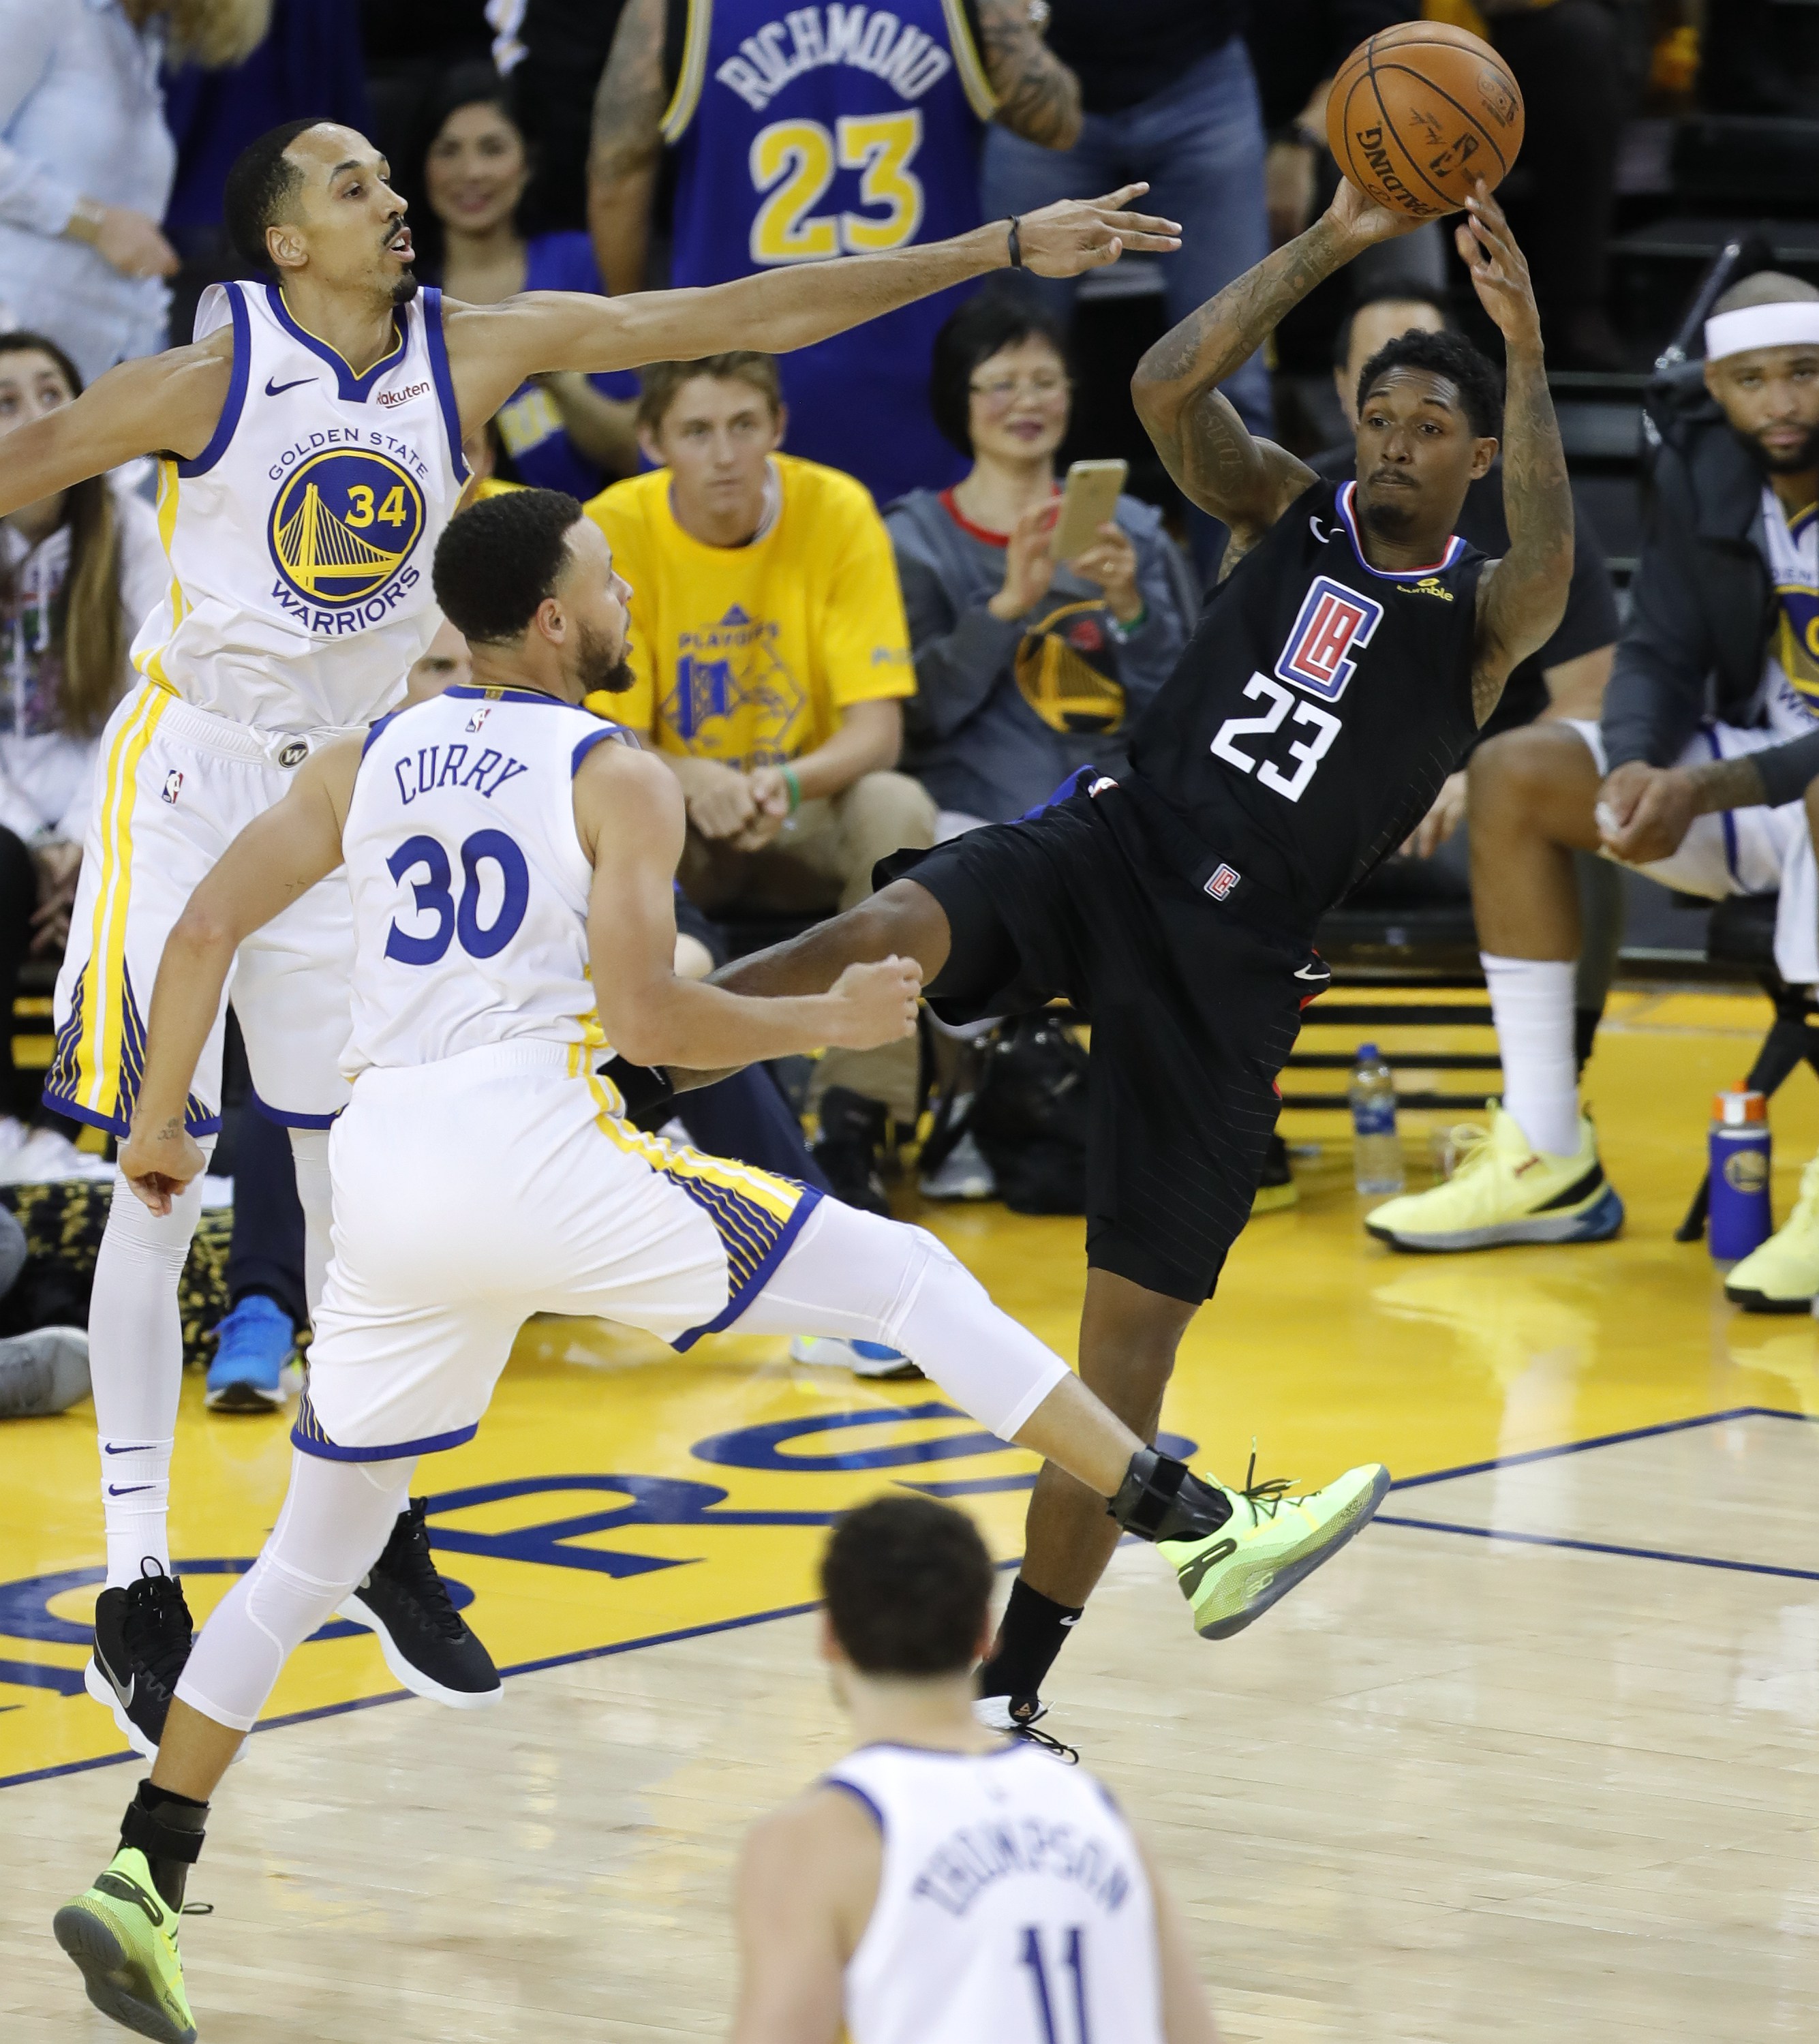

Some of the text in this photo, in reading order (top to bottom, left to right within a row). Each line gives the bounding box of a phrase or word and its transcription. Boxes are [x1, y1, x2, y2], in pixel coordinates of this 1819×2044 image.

[715, 1, 953, 112] RICHMOND
[749, 107, 925, 266] 23
[269, 428, 429, 481] GOLDEN STATE
[344, 485, 407, 528] 34
[271, 565, 421, 635] WARRIORS
[678, 622, 778, 648] PLAYOS
[395, 744, 529, 806] CURRY
[1210, 671, 1343, 803] 23
[383, 828, 530, 966] 30
[1017, 1923, 1090, 2044] 11
